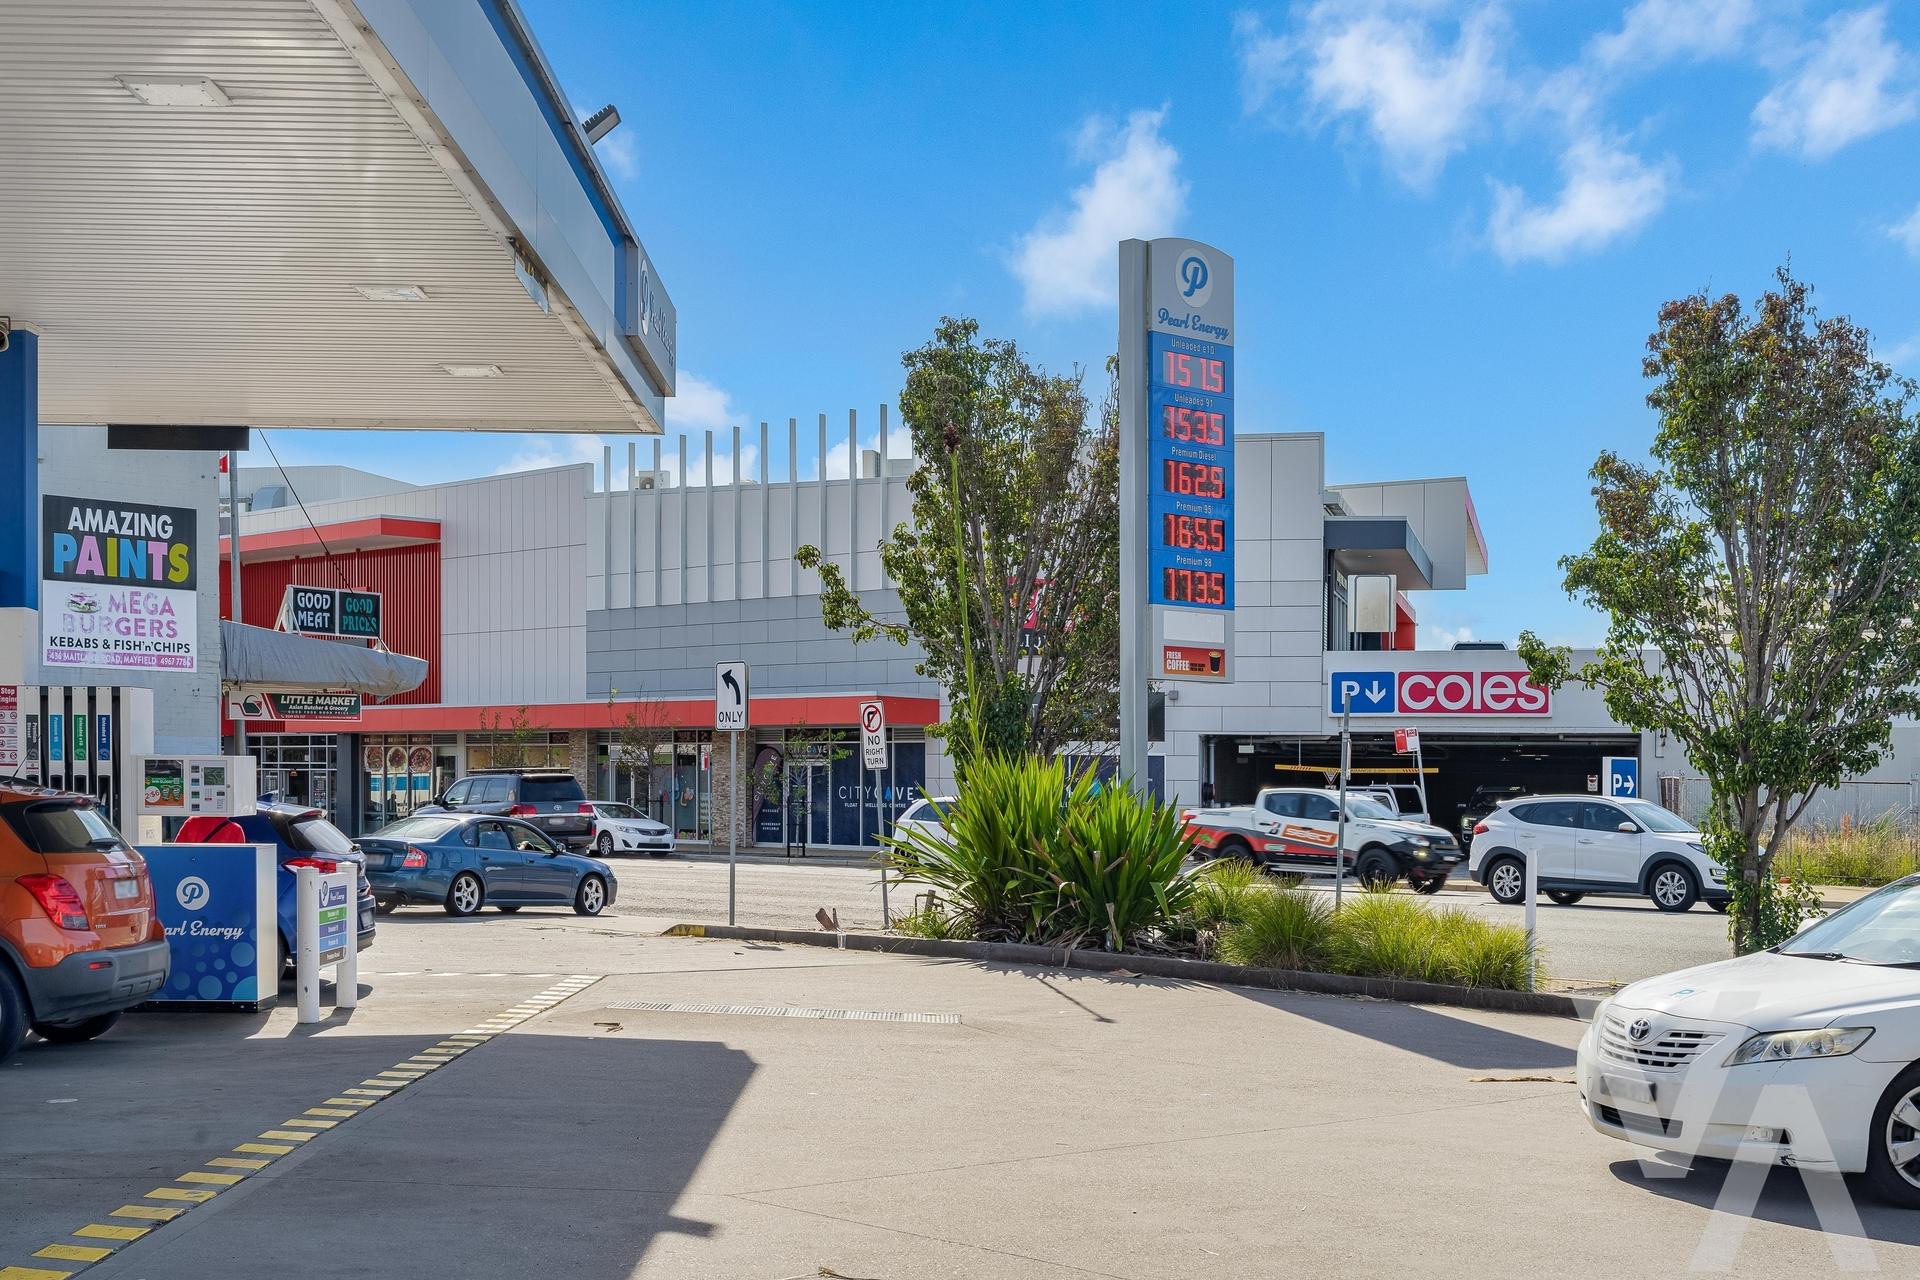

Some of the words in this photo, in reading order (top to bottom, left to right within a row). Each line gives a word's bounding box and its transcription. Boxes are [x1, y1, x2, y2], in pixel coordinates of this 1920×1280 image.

[1158, 307, 1189, 331] Pearl
[1192, 315, 1229, 340] Energy
[1171, 338, 1201, 353] Unleaded
[1202, 345, 1215, 355] e10
[1174, 393, 1205, 407] Unleaded
[1205, 399, 1214, 407] 91
[1171, 447, 1199, 459] Premium
[1199, 449, 1217, 461] Diesel
[1176, 501, 1203, 513] Premium
[68, 507, 173, 539] AMAZING
[53, 532, 189, 583] PAINTS
[1176, 555, 1203, 567] Premium
[108, 591, 175, 616] MEGA
[297, 592, 331, 610] GOOD
[345, 598, 373, 614] GOOD
[62, 613, 178, 639] BURGERS
[297, 611, 331, 629] MEAT
[342, 615, 377, 633] PRICES
[50, 636, 99, 649] KEBABS
[102, 639, 110, 649] &
[123, 655, 156, 665] MAYFIELD
[1166, 660, 1190, 671] COFFEE
[0, 687, 15, 695] Stop
[1341, 681, 1360, 705] P
[1401, 672, 1546, 710] coles
[280, 695, 313, 705] LITTLE
[315, 696, 356, 706] MARKET
[718, 711, 743, 723] ONLY
[867, 735, 880, 746] NO
[1612, 773, 1622, 796] P
[164, 920, 187, 936] arl
[190, 920, 244, 940] Energy
